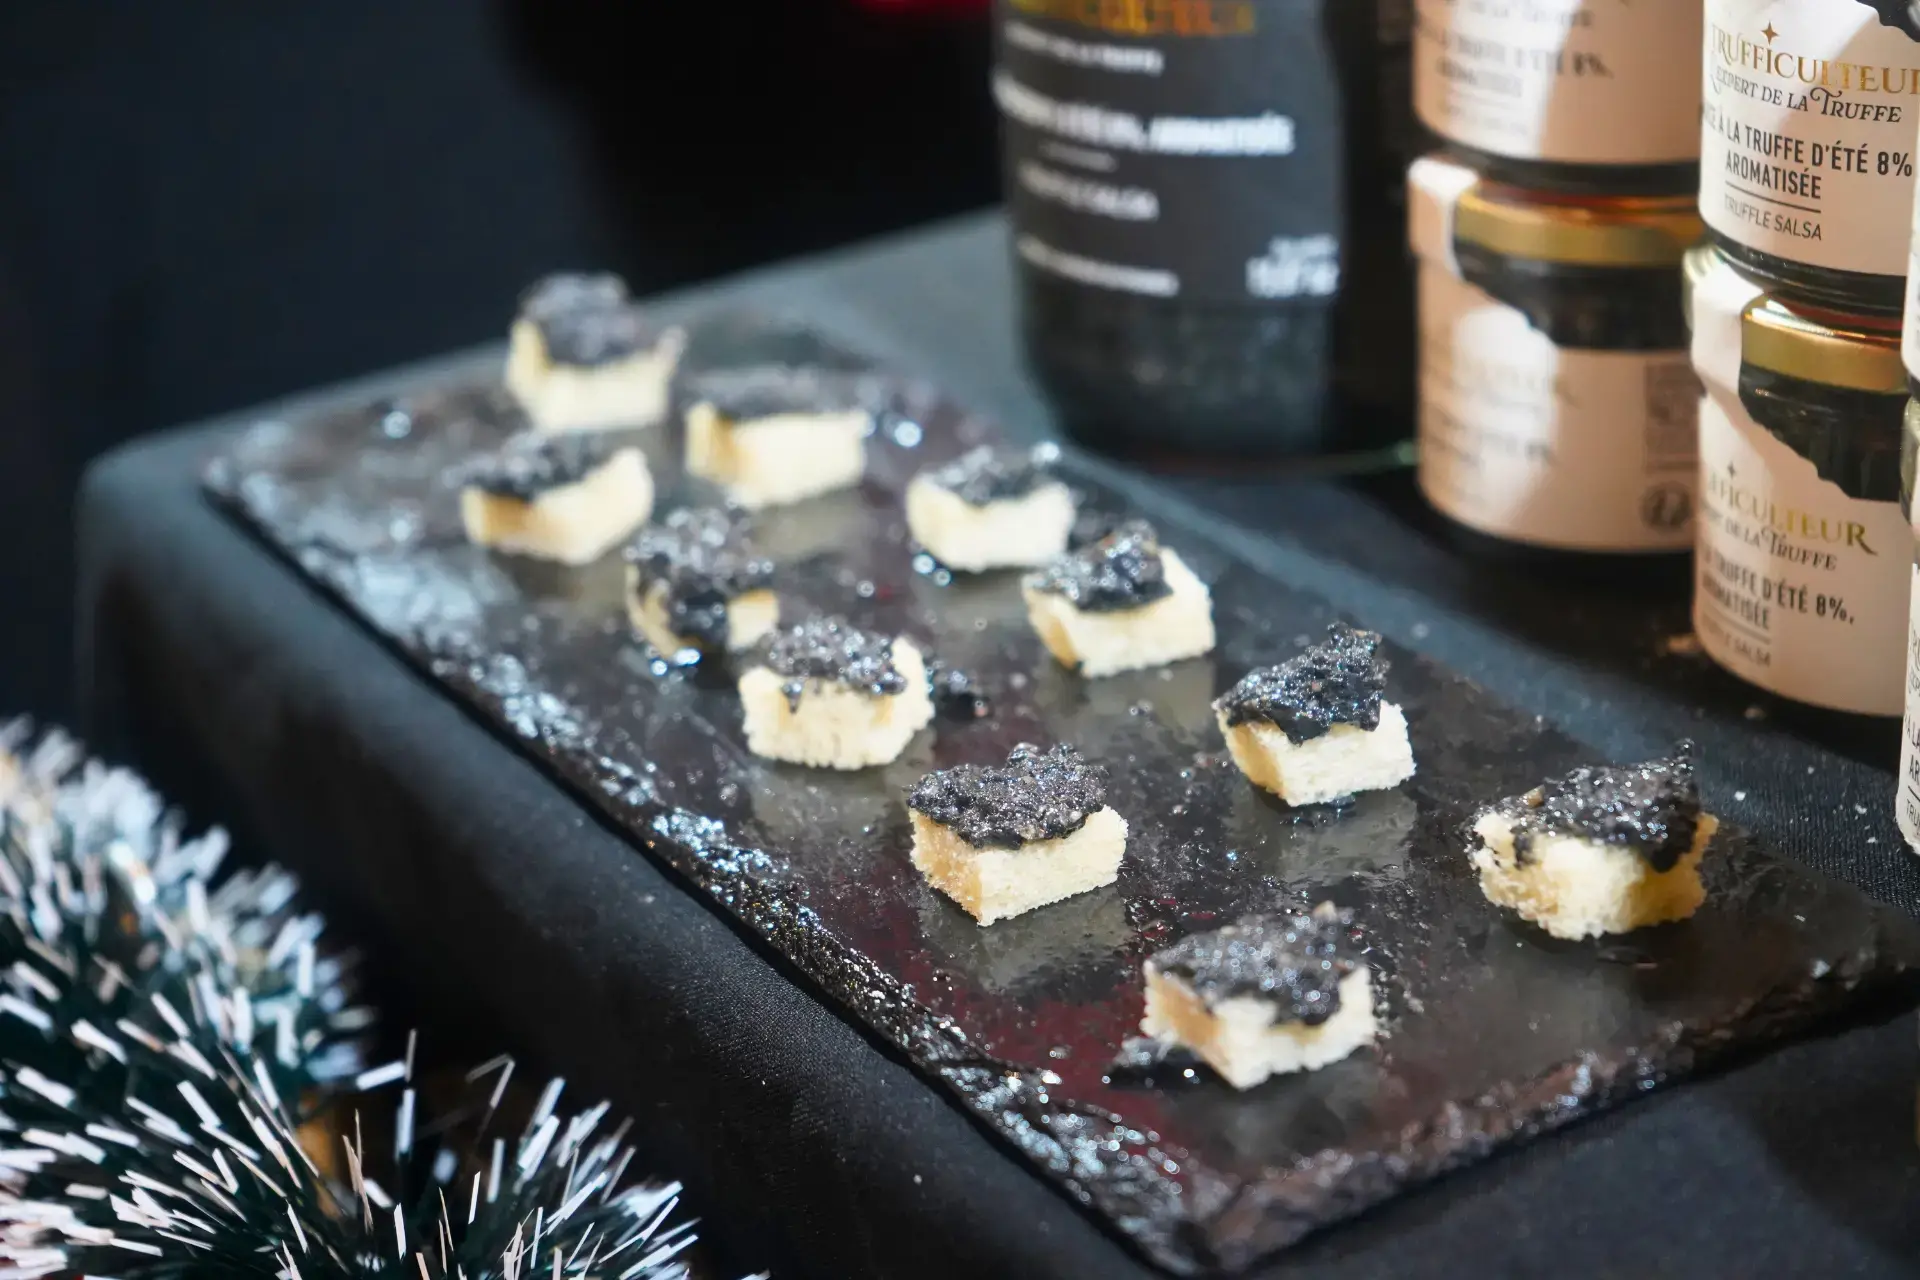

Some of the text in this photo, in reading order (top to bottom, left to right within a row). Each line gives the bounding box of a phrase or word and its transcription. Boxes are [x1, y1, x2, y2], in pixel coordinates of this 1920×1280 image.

[1761, 84, 1783, 106] DE
[1787, 92, 1808, 112] LA
[1810, 86, 1902, 123] TRUFFE
[1727, 116, 1741, 145] LA
[1745, 126, 1804, 164] TRUFFE
[1812, 140, 1868, 174] D'ÉTÉ
[1724, 149, 1822, 199] AROMATISÉE
[1724, 193, 1822, 241] TRUFFLE SALSA
[1761, 524, 1838, 571] TRUFFE
[1763, 577, 1808, 613] D'ÉTÉ
